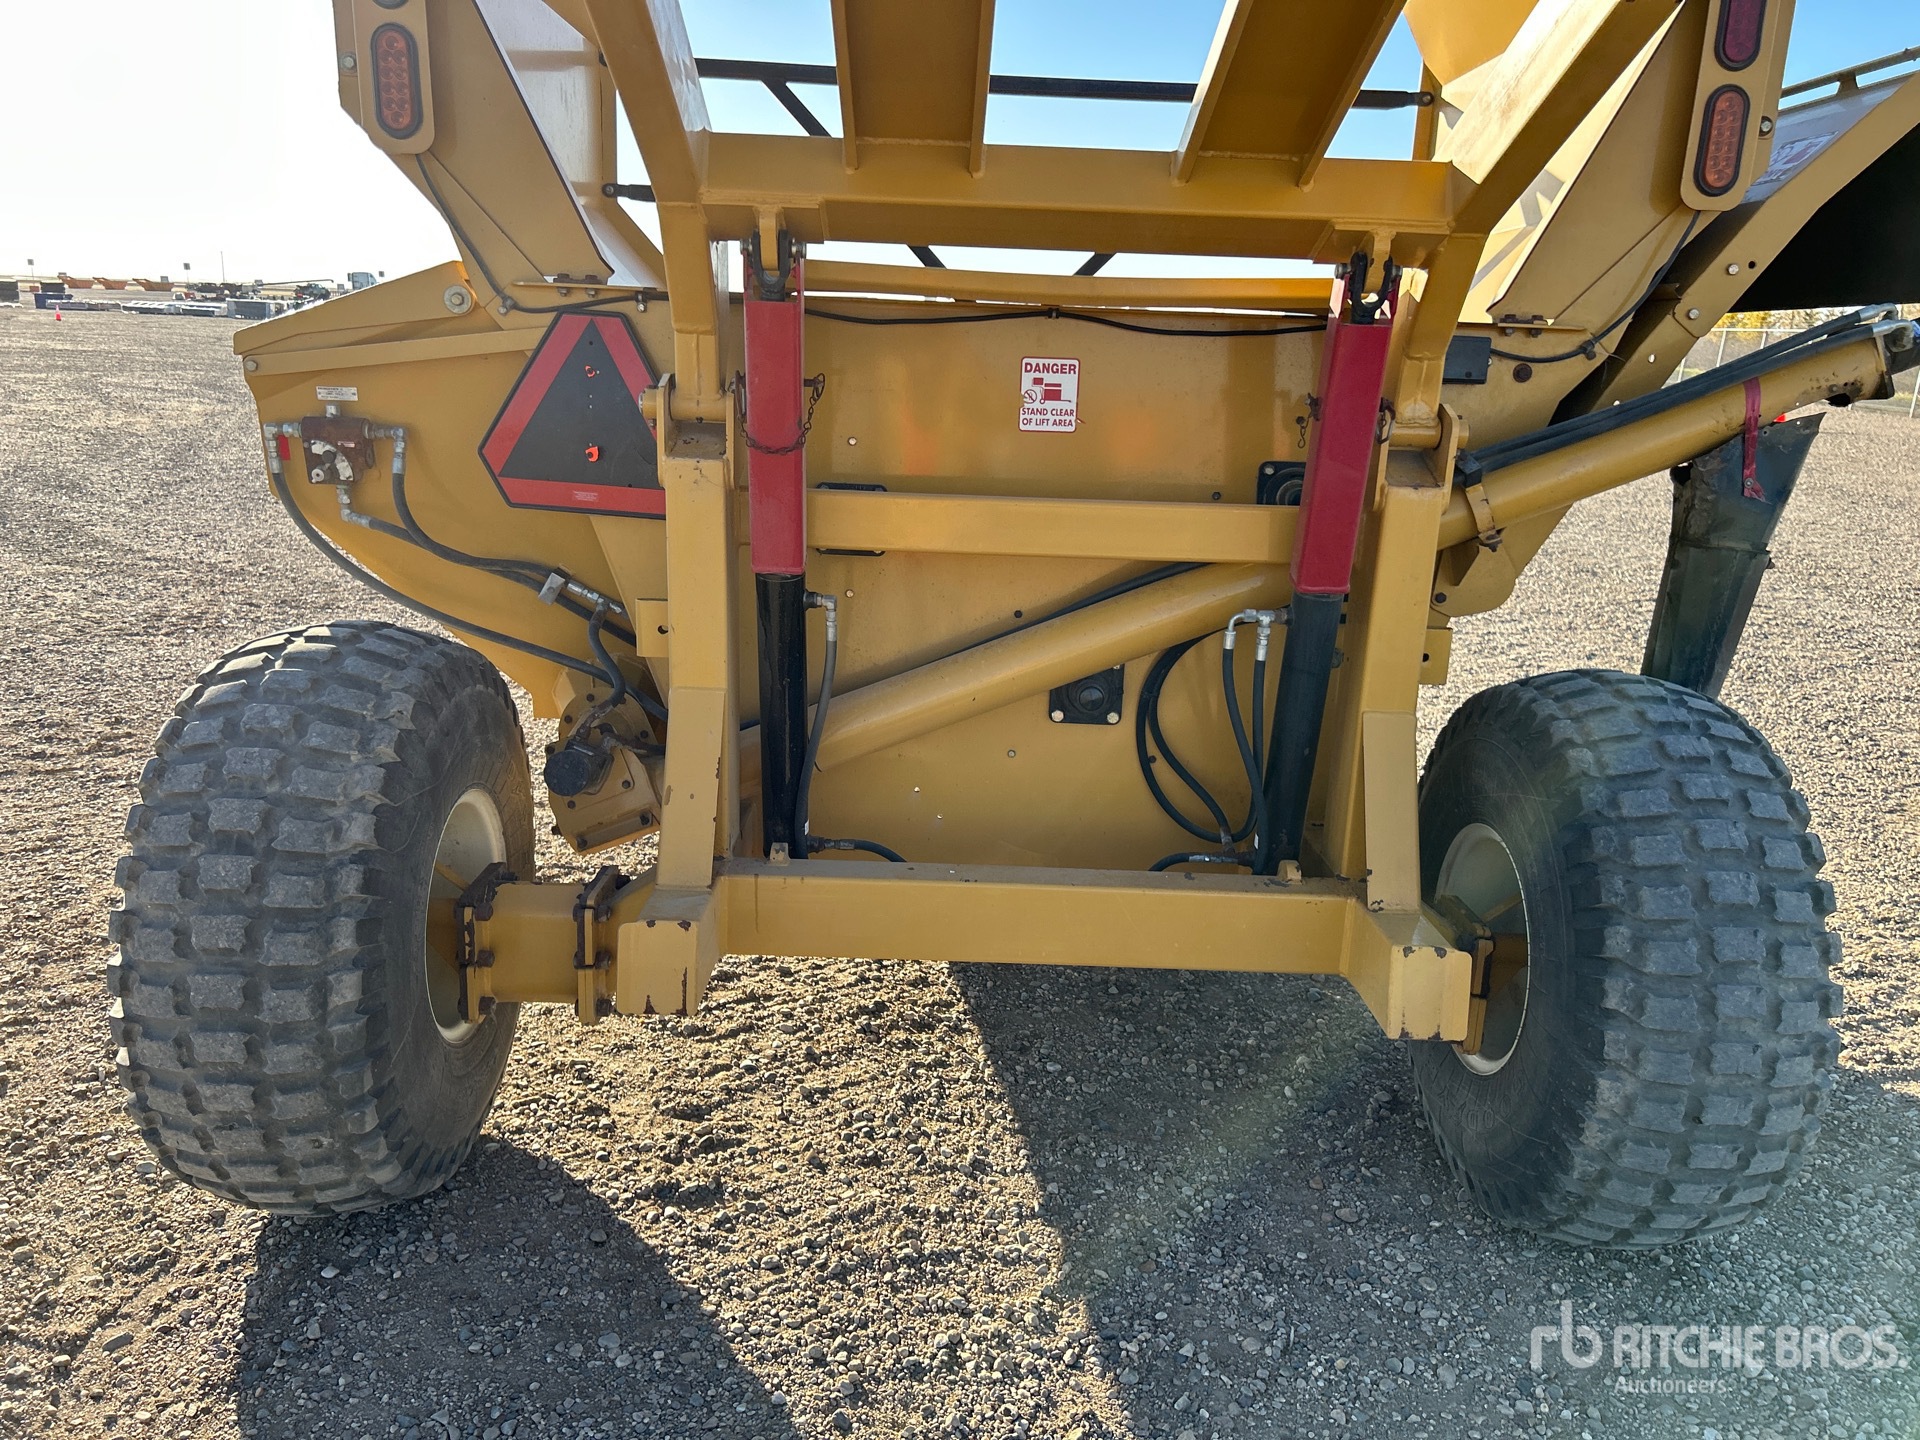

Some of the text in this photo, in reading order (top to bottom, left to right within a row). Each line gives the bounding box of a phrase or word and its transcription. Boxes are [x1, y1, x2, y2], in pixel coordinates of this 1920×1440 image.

[1024, 362, 1077, 374] DANGER
[1021, 407, 1074, 416] STAND CLEAR
[1022, 417, 1073, 427] OF LIFT AREA
